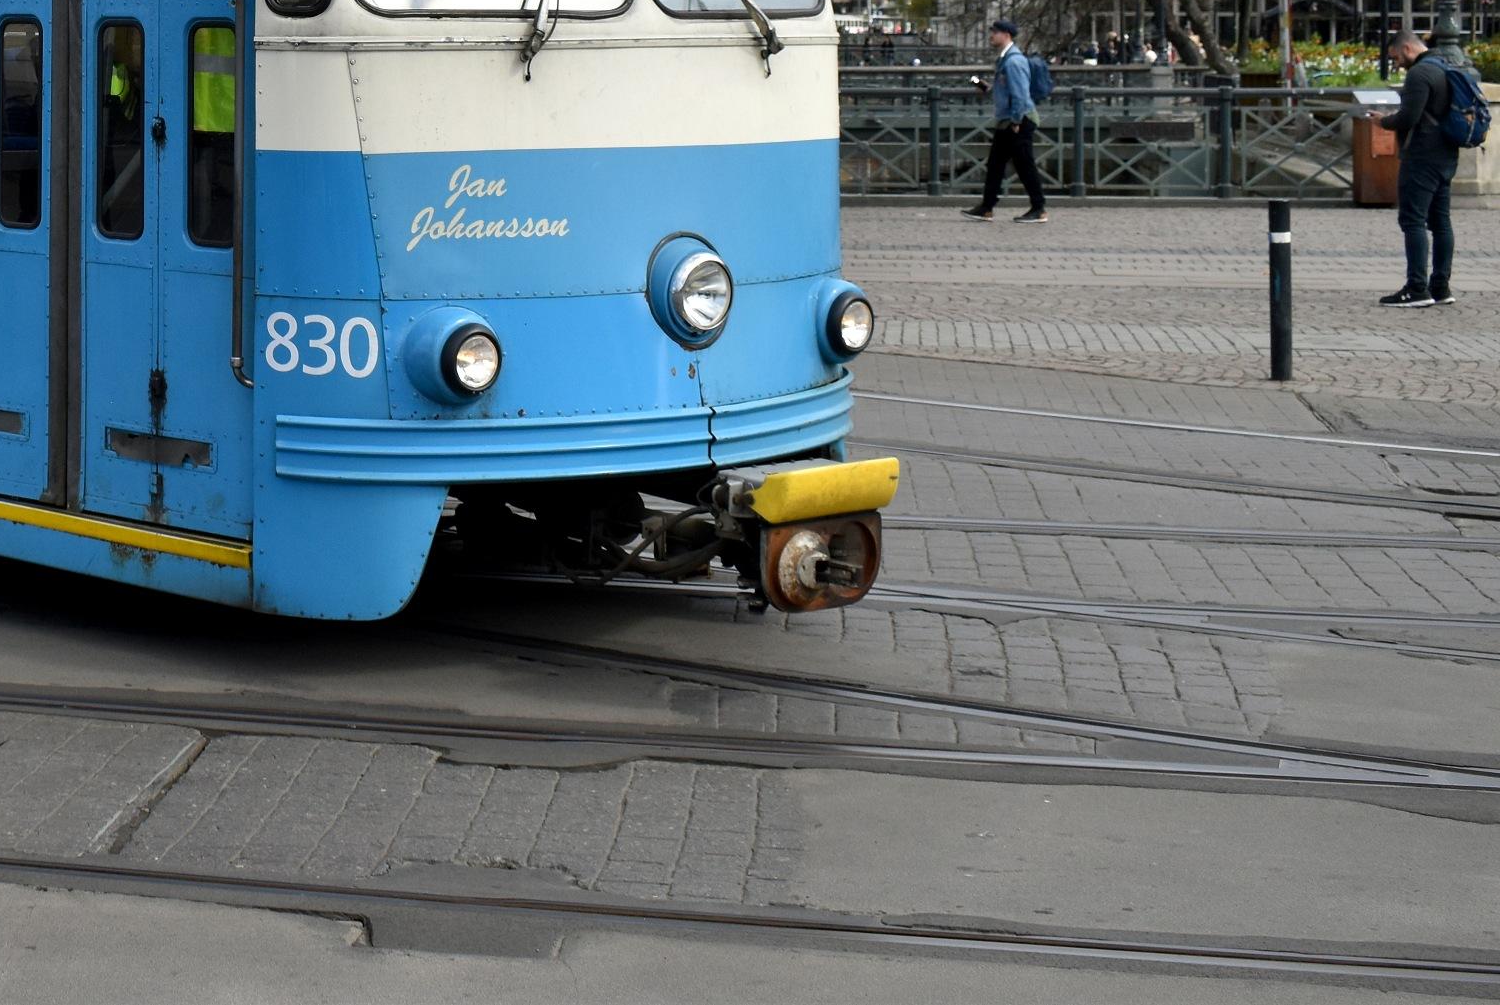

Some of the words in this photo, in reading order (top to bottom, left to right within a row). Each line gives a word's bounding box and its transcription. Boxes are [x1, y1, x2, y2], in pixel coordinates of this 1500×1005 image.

[444, 164, 508, 209] Jan
[406, 206, 570, 252] Johansson
[265, 311, 379, 379] 830
